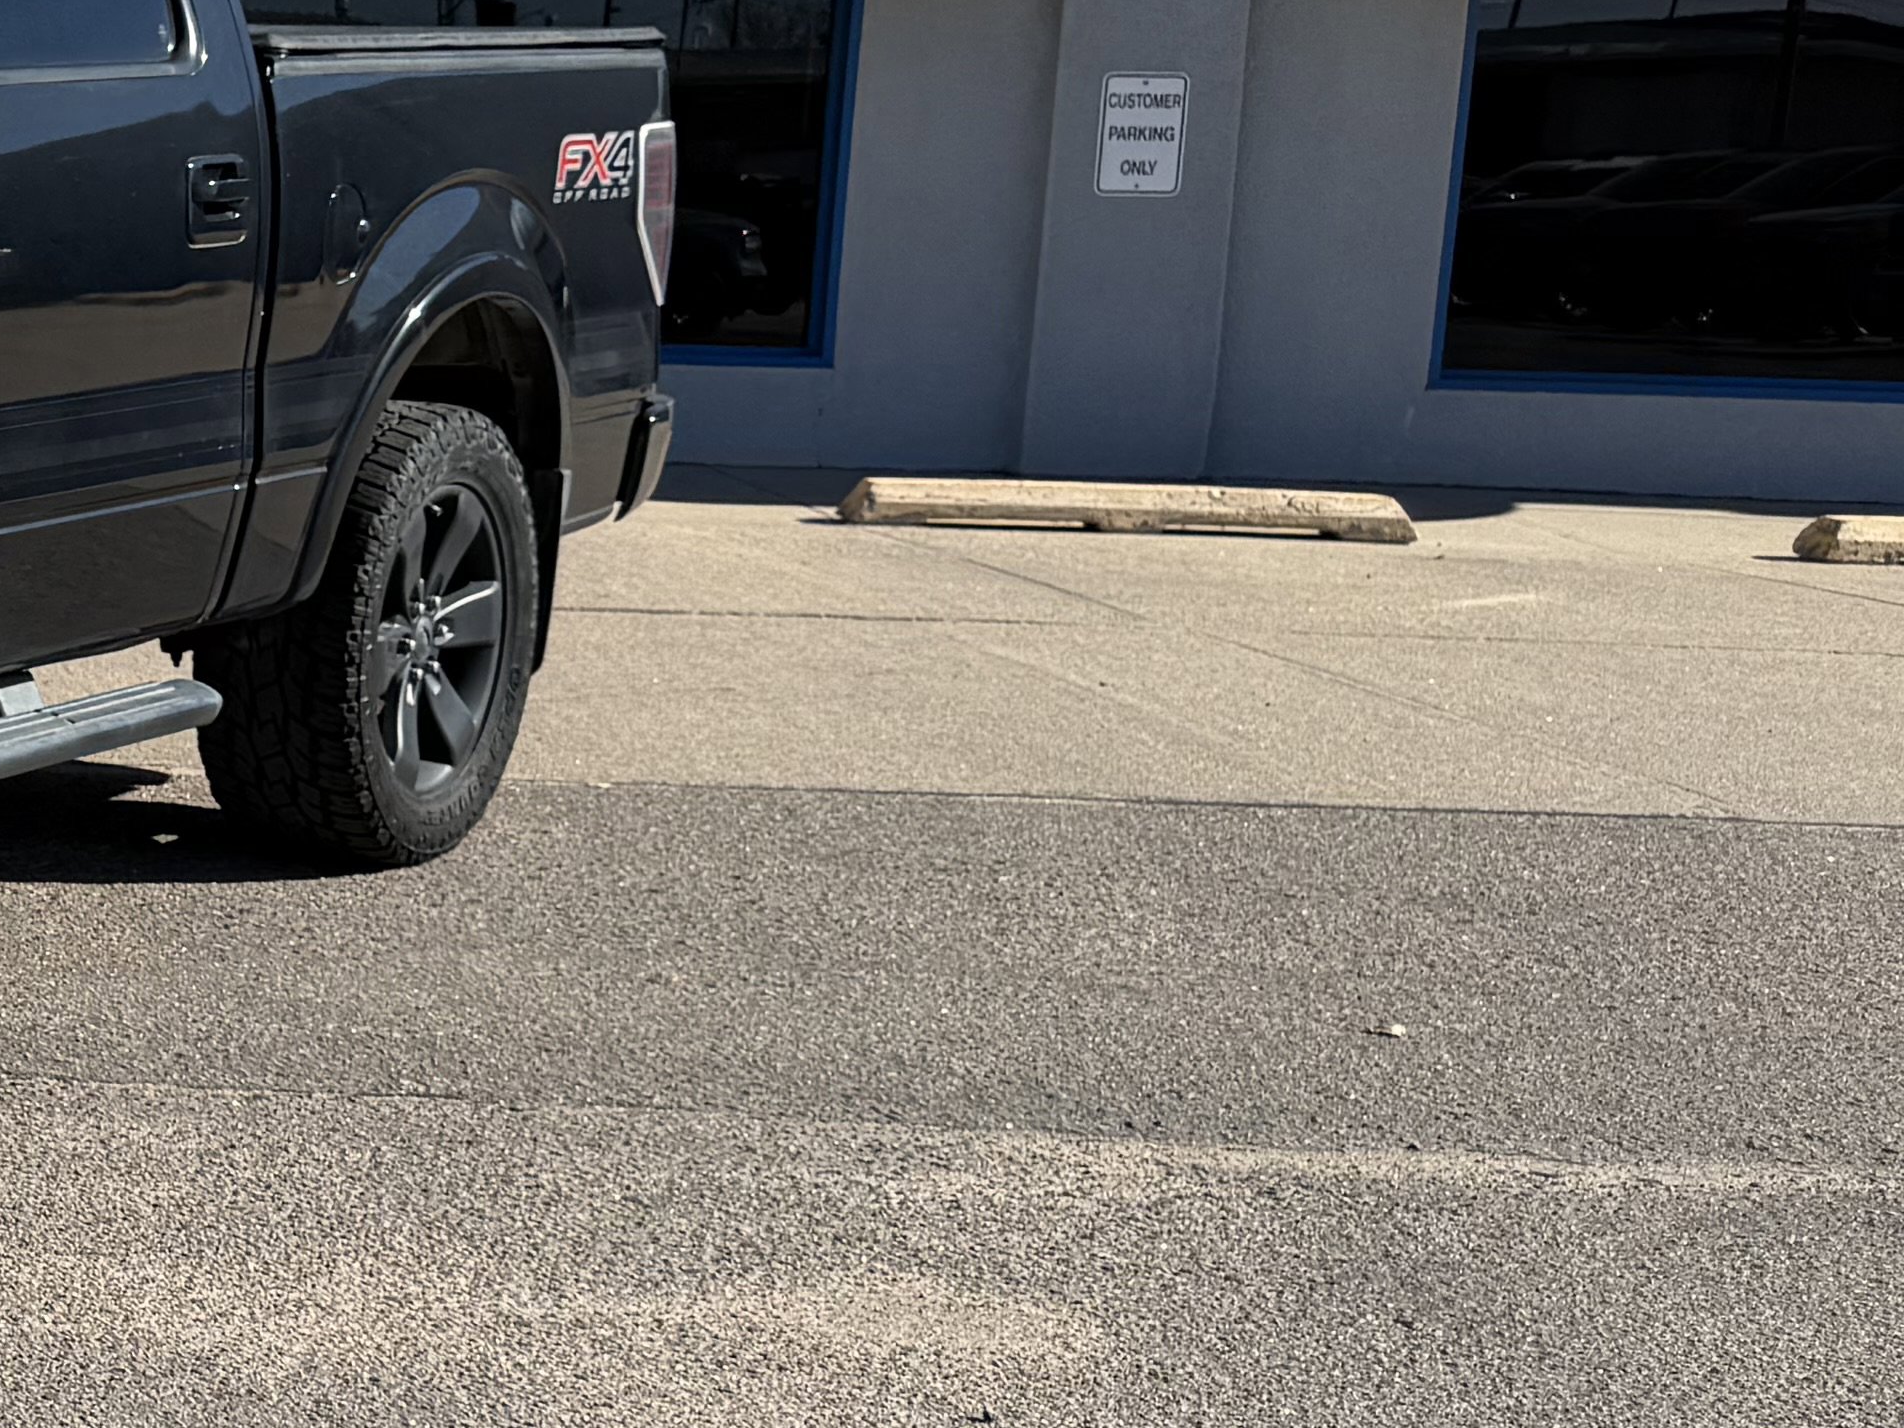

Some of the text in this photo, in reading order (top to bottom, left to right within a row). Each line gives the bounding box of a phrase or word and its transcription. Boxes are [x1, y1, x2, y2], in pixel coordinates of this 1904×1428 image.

[1108, 93, 1181, 109] CUSTOMER
[1108, 125, 1175, 142] PARKING
[555, 130, 634, 190] FX4
[1120, 159, 1158, 176] ONLY
